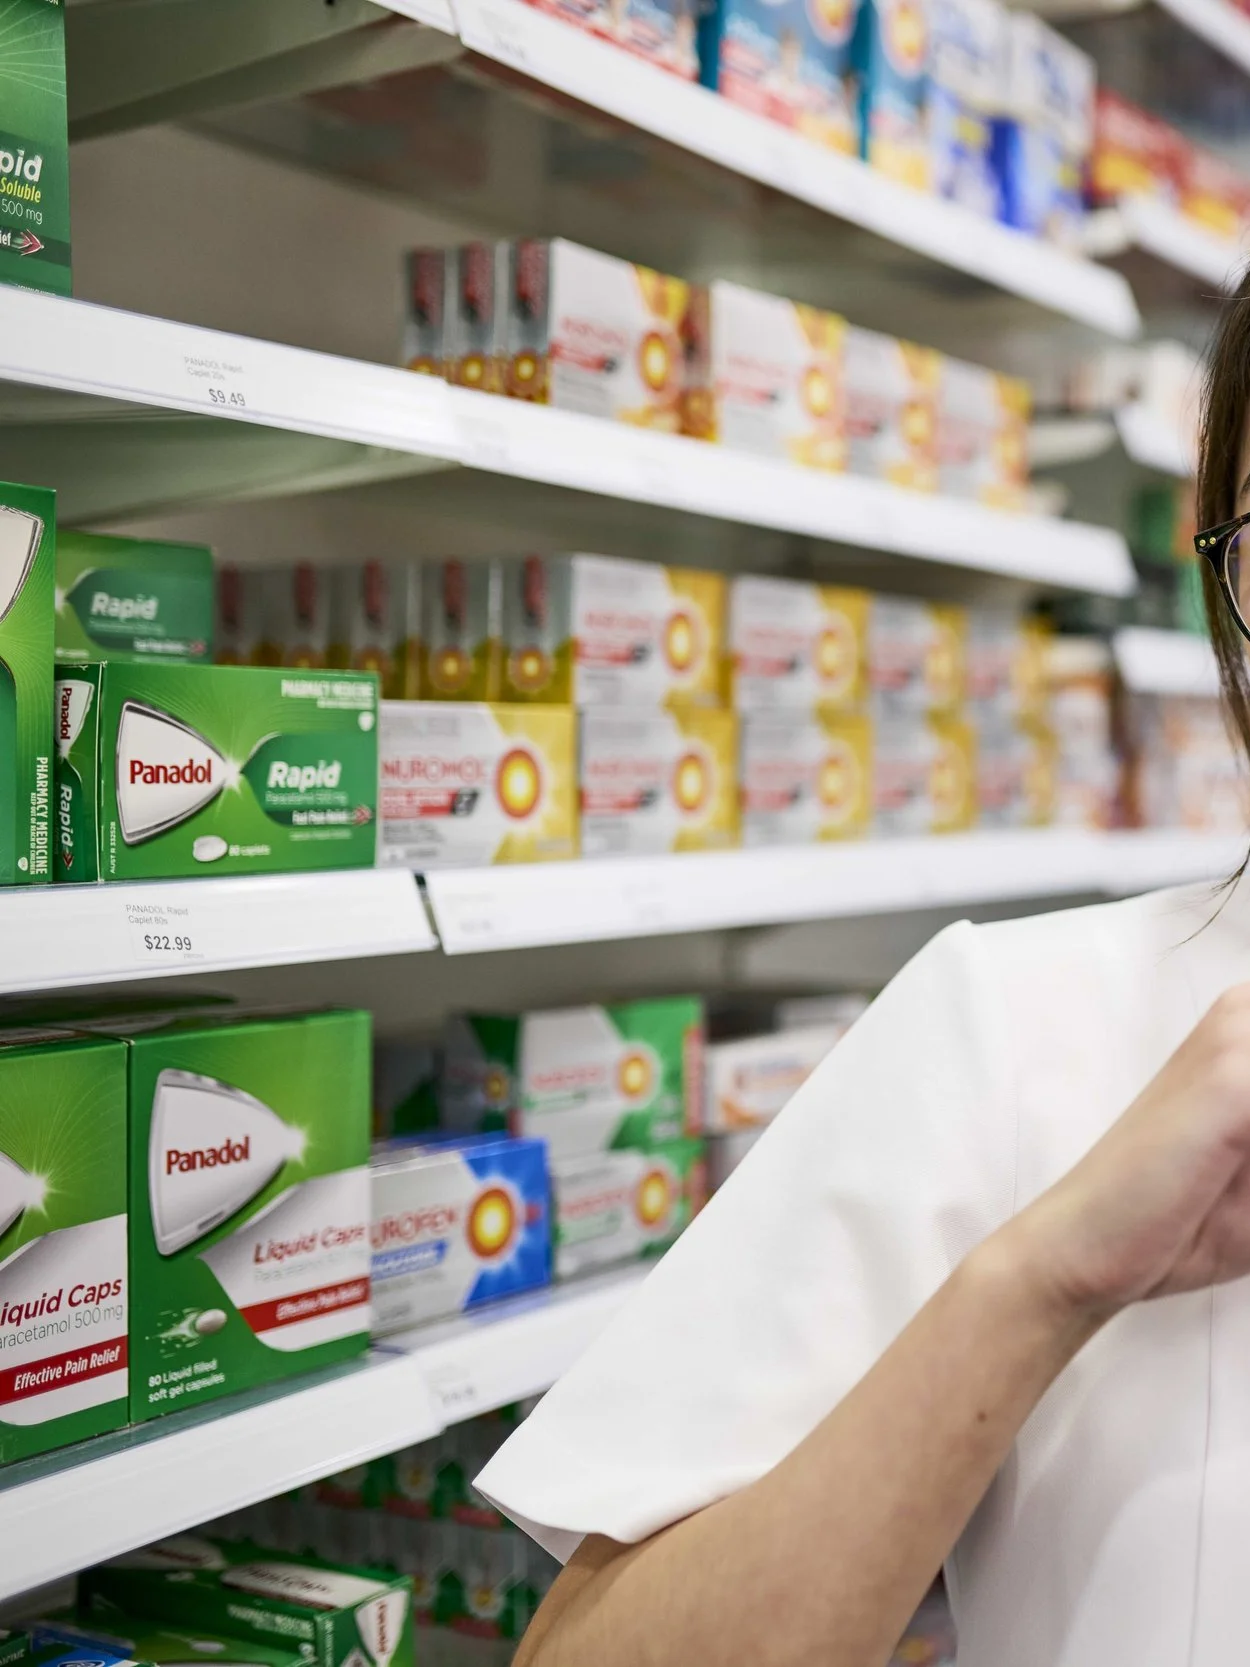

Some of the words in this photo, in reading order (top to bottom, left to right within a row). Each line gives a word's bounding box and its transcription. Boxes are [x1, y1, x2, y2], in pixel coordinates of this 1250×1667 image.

[0, 149, 42, 182] pid
[0, 177, 42, 203] Soluble
[1, 199, 24, 217] 500
[26, 208, 43, 225] mg
[0, 230, 12, 247] ief
[208, 388, 246, 407] $9.49
[90, 591, 159, 622] Rapid
[60, 687, 72, 740] Panadol
[130, 758, 212, 784] Panadol
[267, 760, 342, 793] Rapid
[36, 756, 48, 819] PHARMACY
[60, 784, 73, 847] Rapid
[36, 821, 48, 875] MEDICINE
[125, 904, 165, 915] PANADOL
[128, 915, 153, 925] Caplet
[144, 934, 192, 951] $22.99
[166, 1134, 250, 1175] Panadol
[254, 1230, 318, 1265] Liquid
[0, 1288, 63, 1328] iquid
[68, 1278, 122, 1308] Caps
[0, 1318, 71, 1349] aracetamol
[75, 1307, 101, 1329] 500
[103, 1303, 124, 1321] mg
[14, 1364, 63, 1392] Effective
[64, 1354, 89, 1377] Pain
[90, 1345, 121, 1368] Relief
[148, 1374, 162, 1388] 80
[162, 1365, 193, 1385] Liquid
[193, 1358, 218, 1376] filled
[148, 1387, 168, 1403] soft
[169, 1381, 185, 1399] gel
[185, 1371, 226, 1393] capsules
